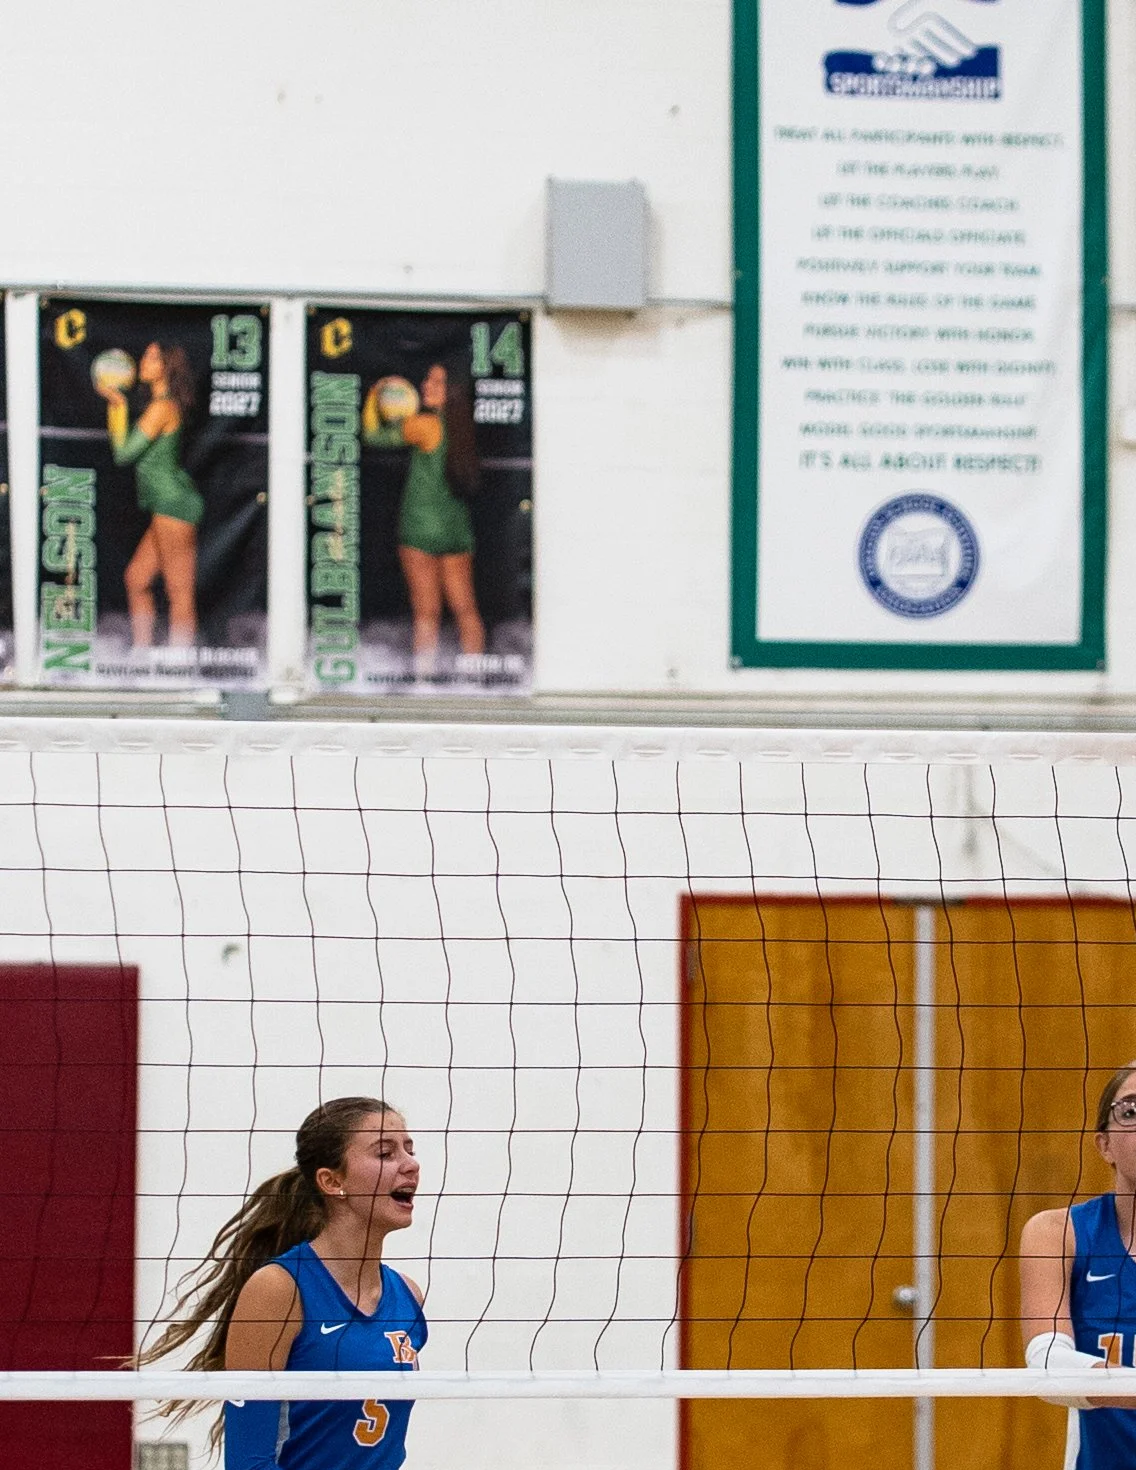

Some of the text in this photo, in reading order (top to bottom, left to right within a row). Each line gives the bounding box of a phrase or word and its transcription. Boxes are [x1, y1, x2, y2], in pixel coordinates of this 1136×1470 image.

[210, 313, 263, 371] 13
[470, 322, 525, 378] 14
[881, 450, 945, 474] ABOUT
[42, 463, 98, 673] NELSON
